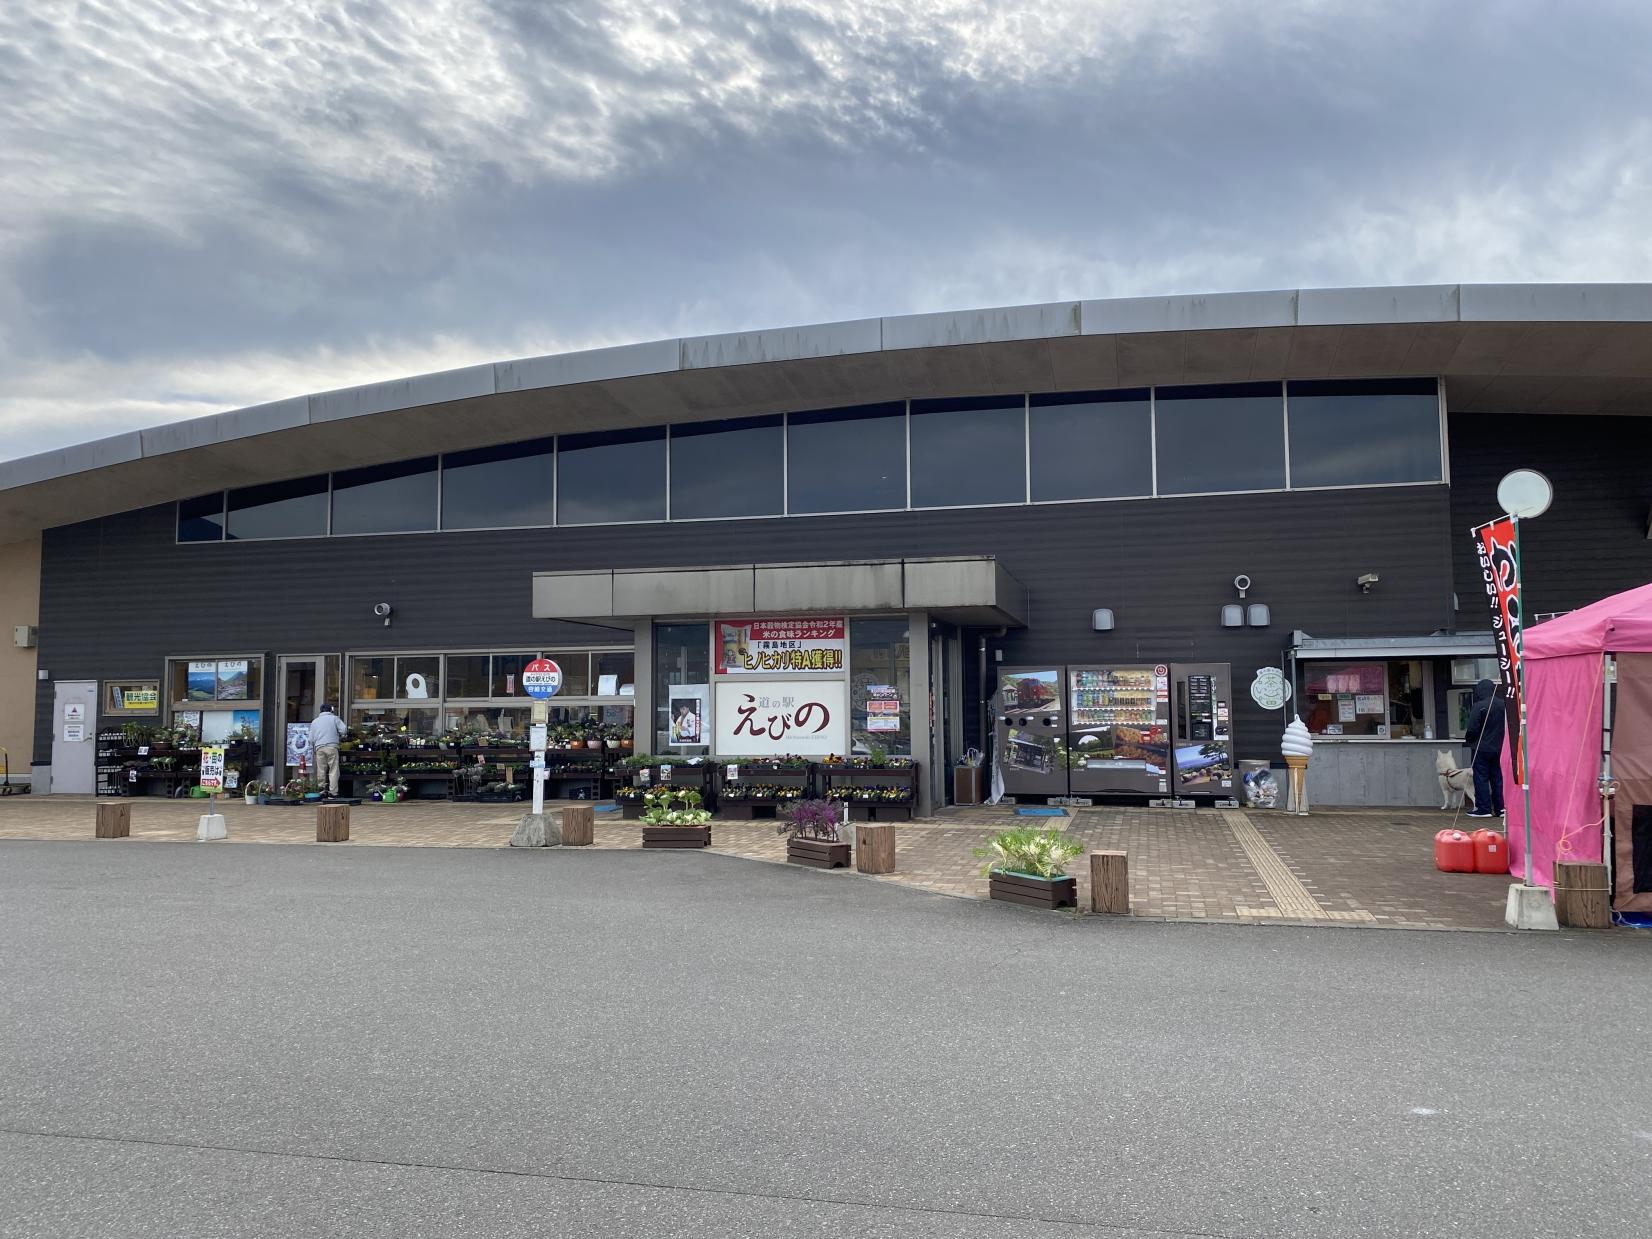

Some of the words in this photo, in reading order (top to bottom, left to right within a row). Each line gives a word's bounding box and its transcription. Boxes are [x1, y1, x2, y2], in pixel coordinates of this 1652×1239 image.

[762, 629, 836, 639] 米の食味ランキング
[757, 640, 802, 649] 「霧島地区」
[742, 649, 843, 670] ヒノヒカリ特A獲得!!
[1492, 614, 1516, 699] ジューシー!!
[531, 663, 551, 671] バス
[526, 675, 556, 683] 道の駅えびの
[126, 692, 157, 701] 観光協会
[758, 696, 795, 708] 道の駅
[732, 693, 830, 741] えびの
